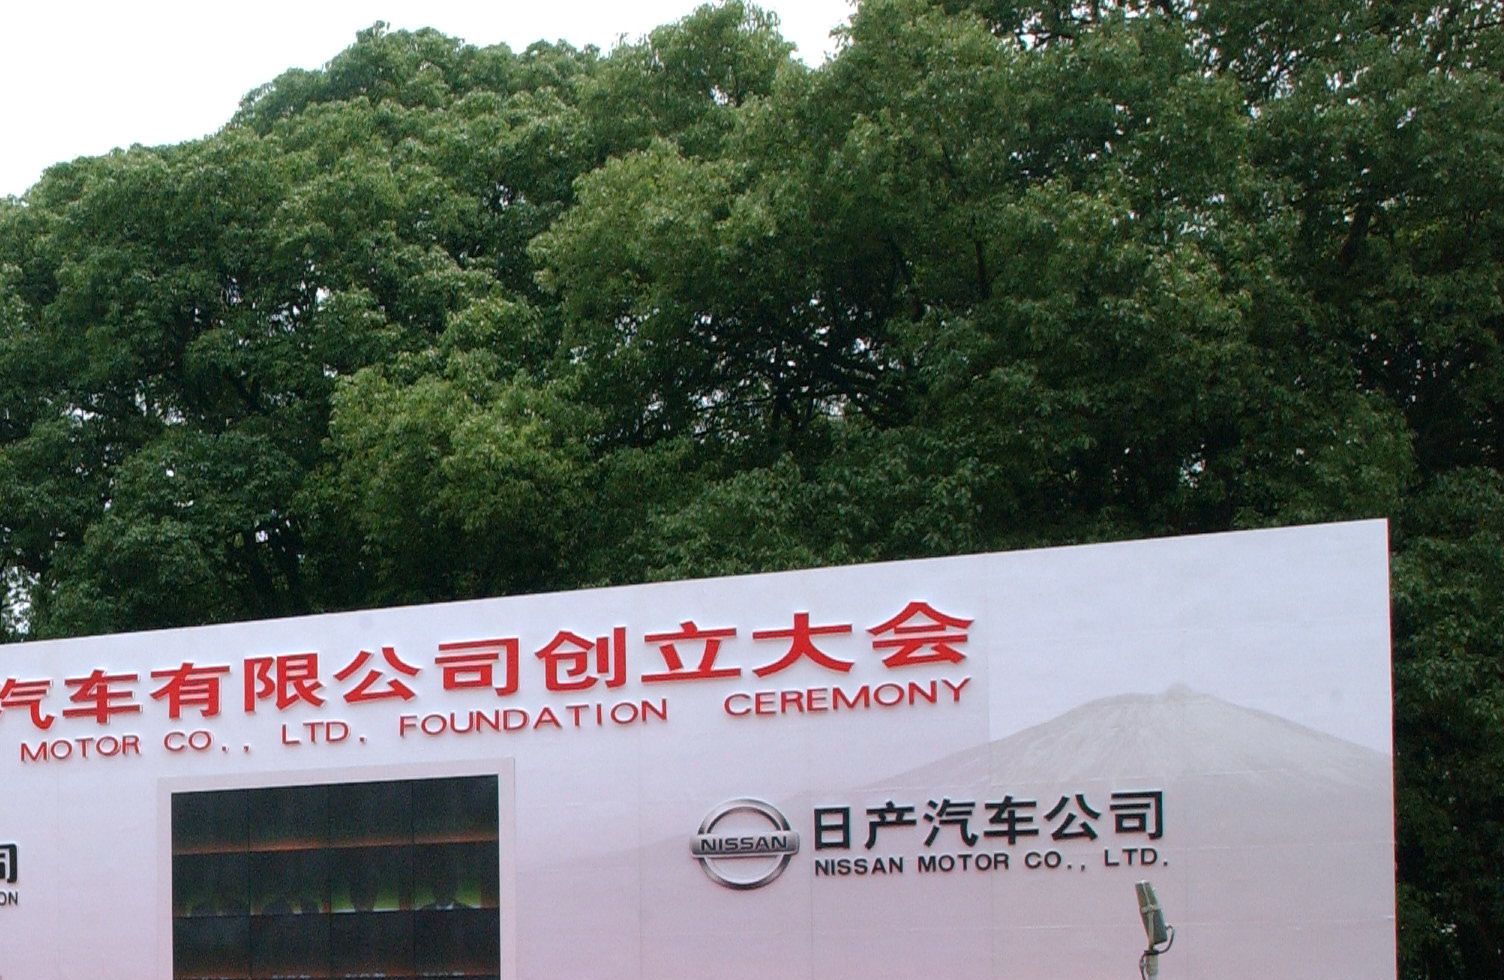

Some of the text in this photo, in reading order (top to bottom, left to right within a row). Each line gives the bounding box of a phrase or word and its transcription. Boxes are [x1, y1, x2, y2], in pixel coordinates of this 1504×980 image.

[20, 735, 141, 763] MOTOR
[398, 698, 669, 738] FOUNDATION
[723, 677, 972, 717] CEREMONY
[813, 791, 1164, 850] 日产汽车公司
[700, 836, 787, 851] NISSAN
[814, 856, 904, 877] NISSAN
[917, 853, 1010, 873] MOTOR
[1104, 847, 1169, 867] LTD.
